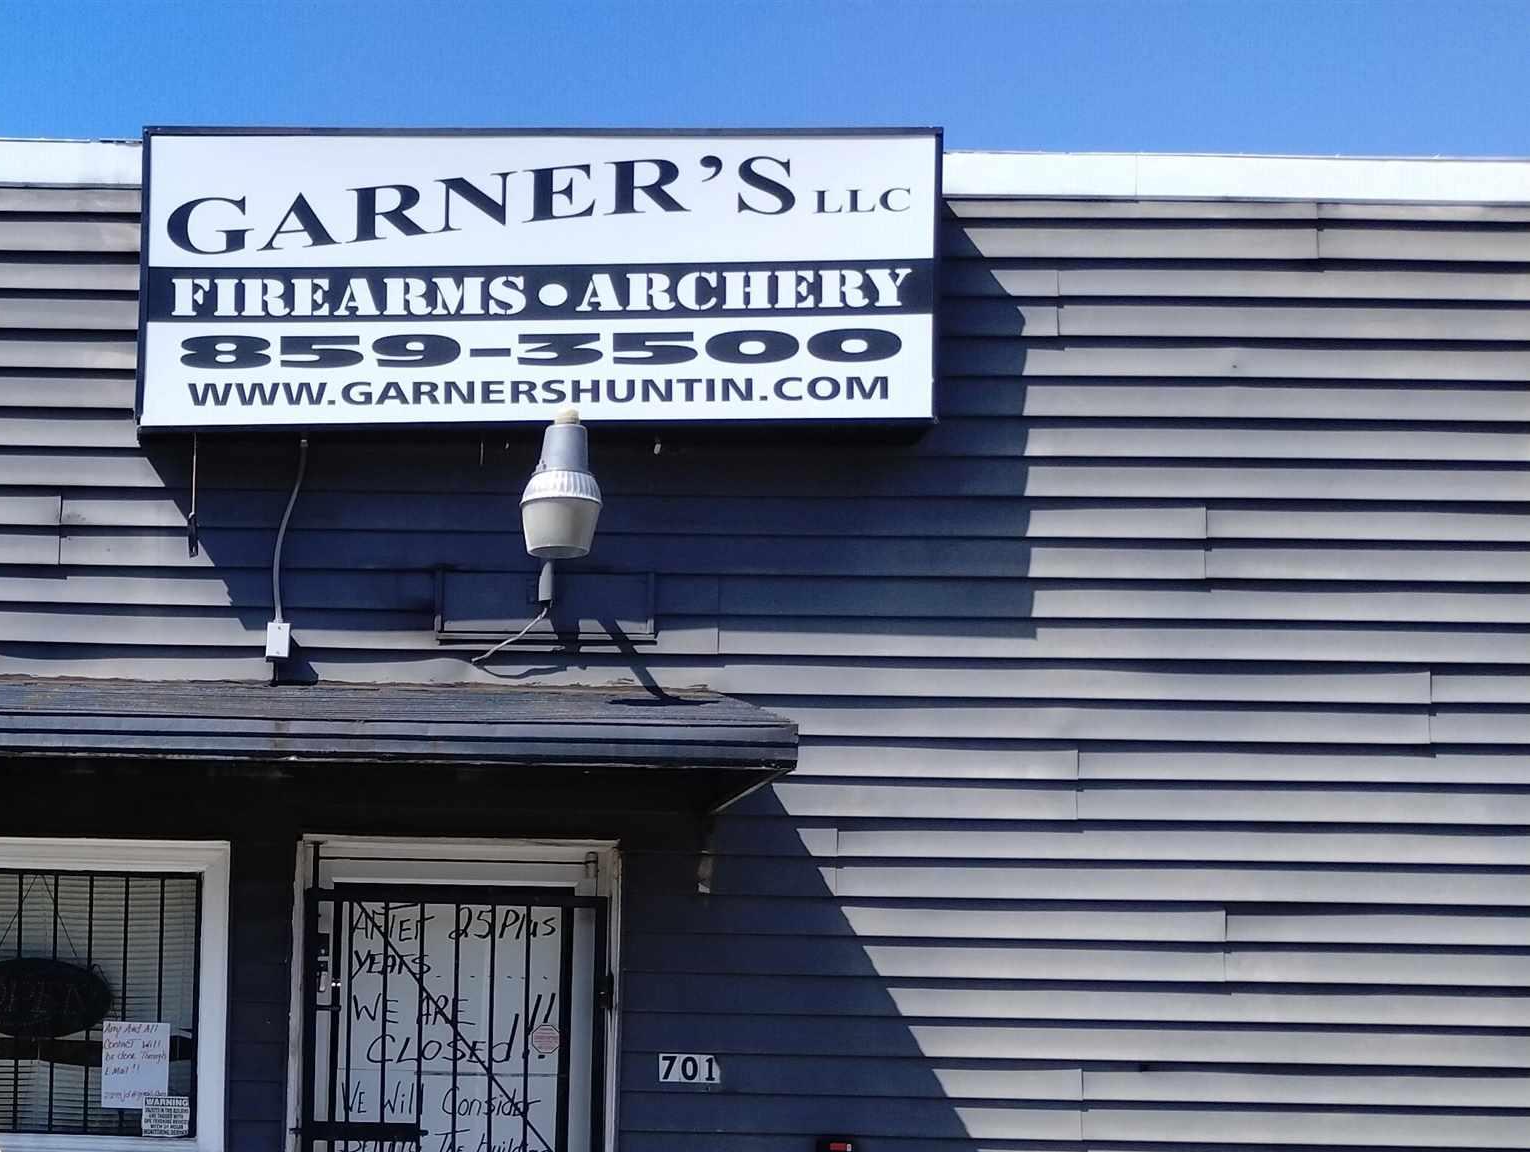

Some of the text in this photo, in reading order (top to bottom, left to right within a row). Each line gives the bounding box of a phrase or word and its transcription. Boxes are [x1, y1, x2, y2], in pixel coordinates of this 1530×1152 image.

[813, 187, 912, 213] LLC
[172, 268, 912, 317] FIREARMS ARCHERY
[180, 328, 902, 370] 859-3500
[189, 376, 890, 408] WWW.GARNERSHUNTIN.COM
[448, 907, 493, 940] 25
[661, 1055, 716, 1082] 701
[145, 1098, 189, 1107] WARNING
